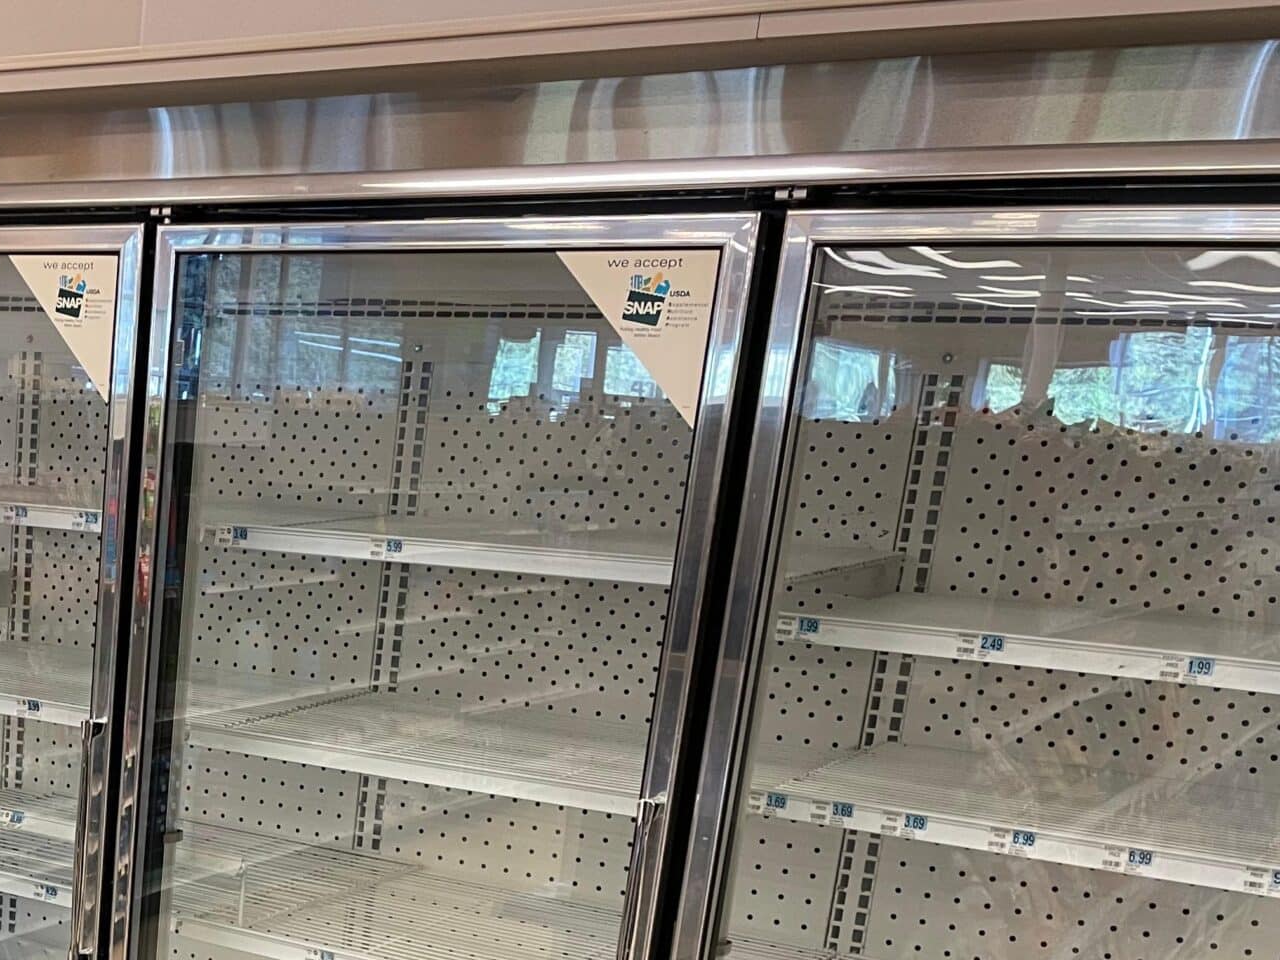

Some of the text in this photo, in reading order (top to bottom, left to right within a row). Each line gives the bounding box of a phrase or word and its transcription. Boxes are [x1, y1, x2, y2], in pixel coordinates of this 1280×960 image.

[43, 262, 95, 271] we accept
[607, 258, 684, 269] we accept
[56, 297, 84, 309] SNAP
[623, 301, 664, 315] SNAP
[386, 541, 402, 553] 5.99
[799, 620, 819, 633] 1.99
[981, 637, 1003, 651] 2.49
[1188, 660, 1211, 675] 1.99
[766, 795, 786, 809] 3.69
[832, 804, 853, 818] 3.69
[904, 815, 925, 830] 3.69
[1012, 832, 1036, 847] 6.99
[1128, 850, 1152, 865] 6.99
